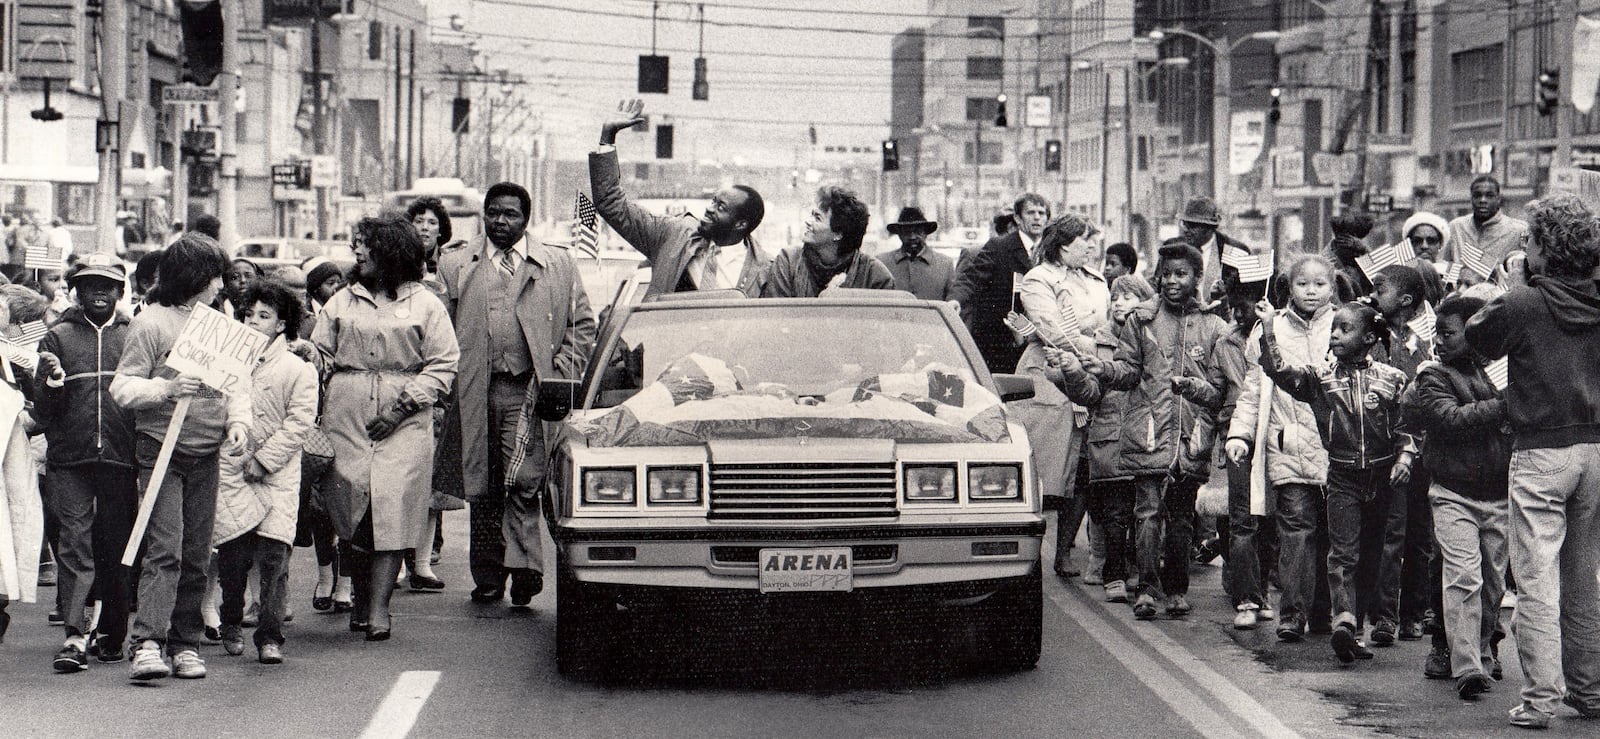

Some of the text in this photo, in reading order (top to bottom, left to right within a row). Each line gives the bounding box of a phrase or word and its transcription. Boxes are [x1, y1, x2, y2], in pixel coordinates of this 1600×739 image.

[183, 305, 268, 366] FAIRVIEW
[176, 340, 216, 371] CHOIR
[764, 555, 848, 571] ARENA
